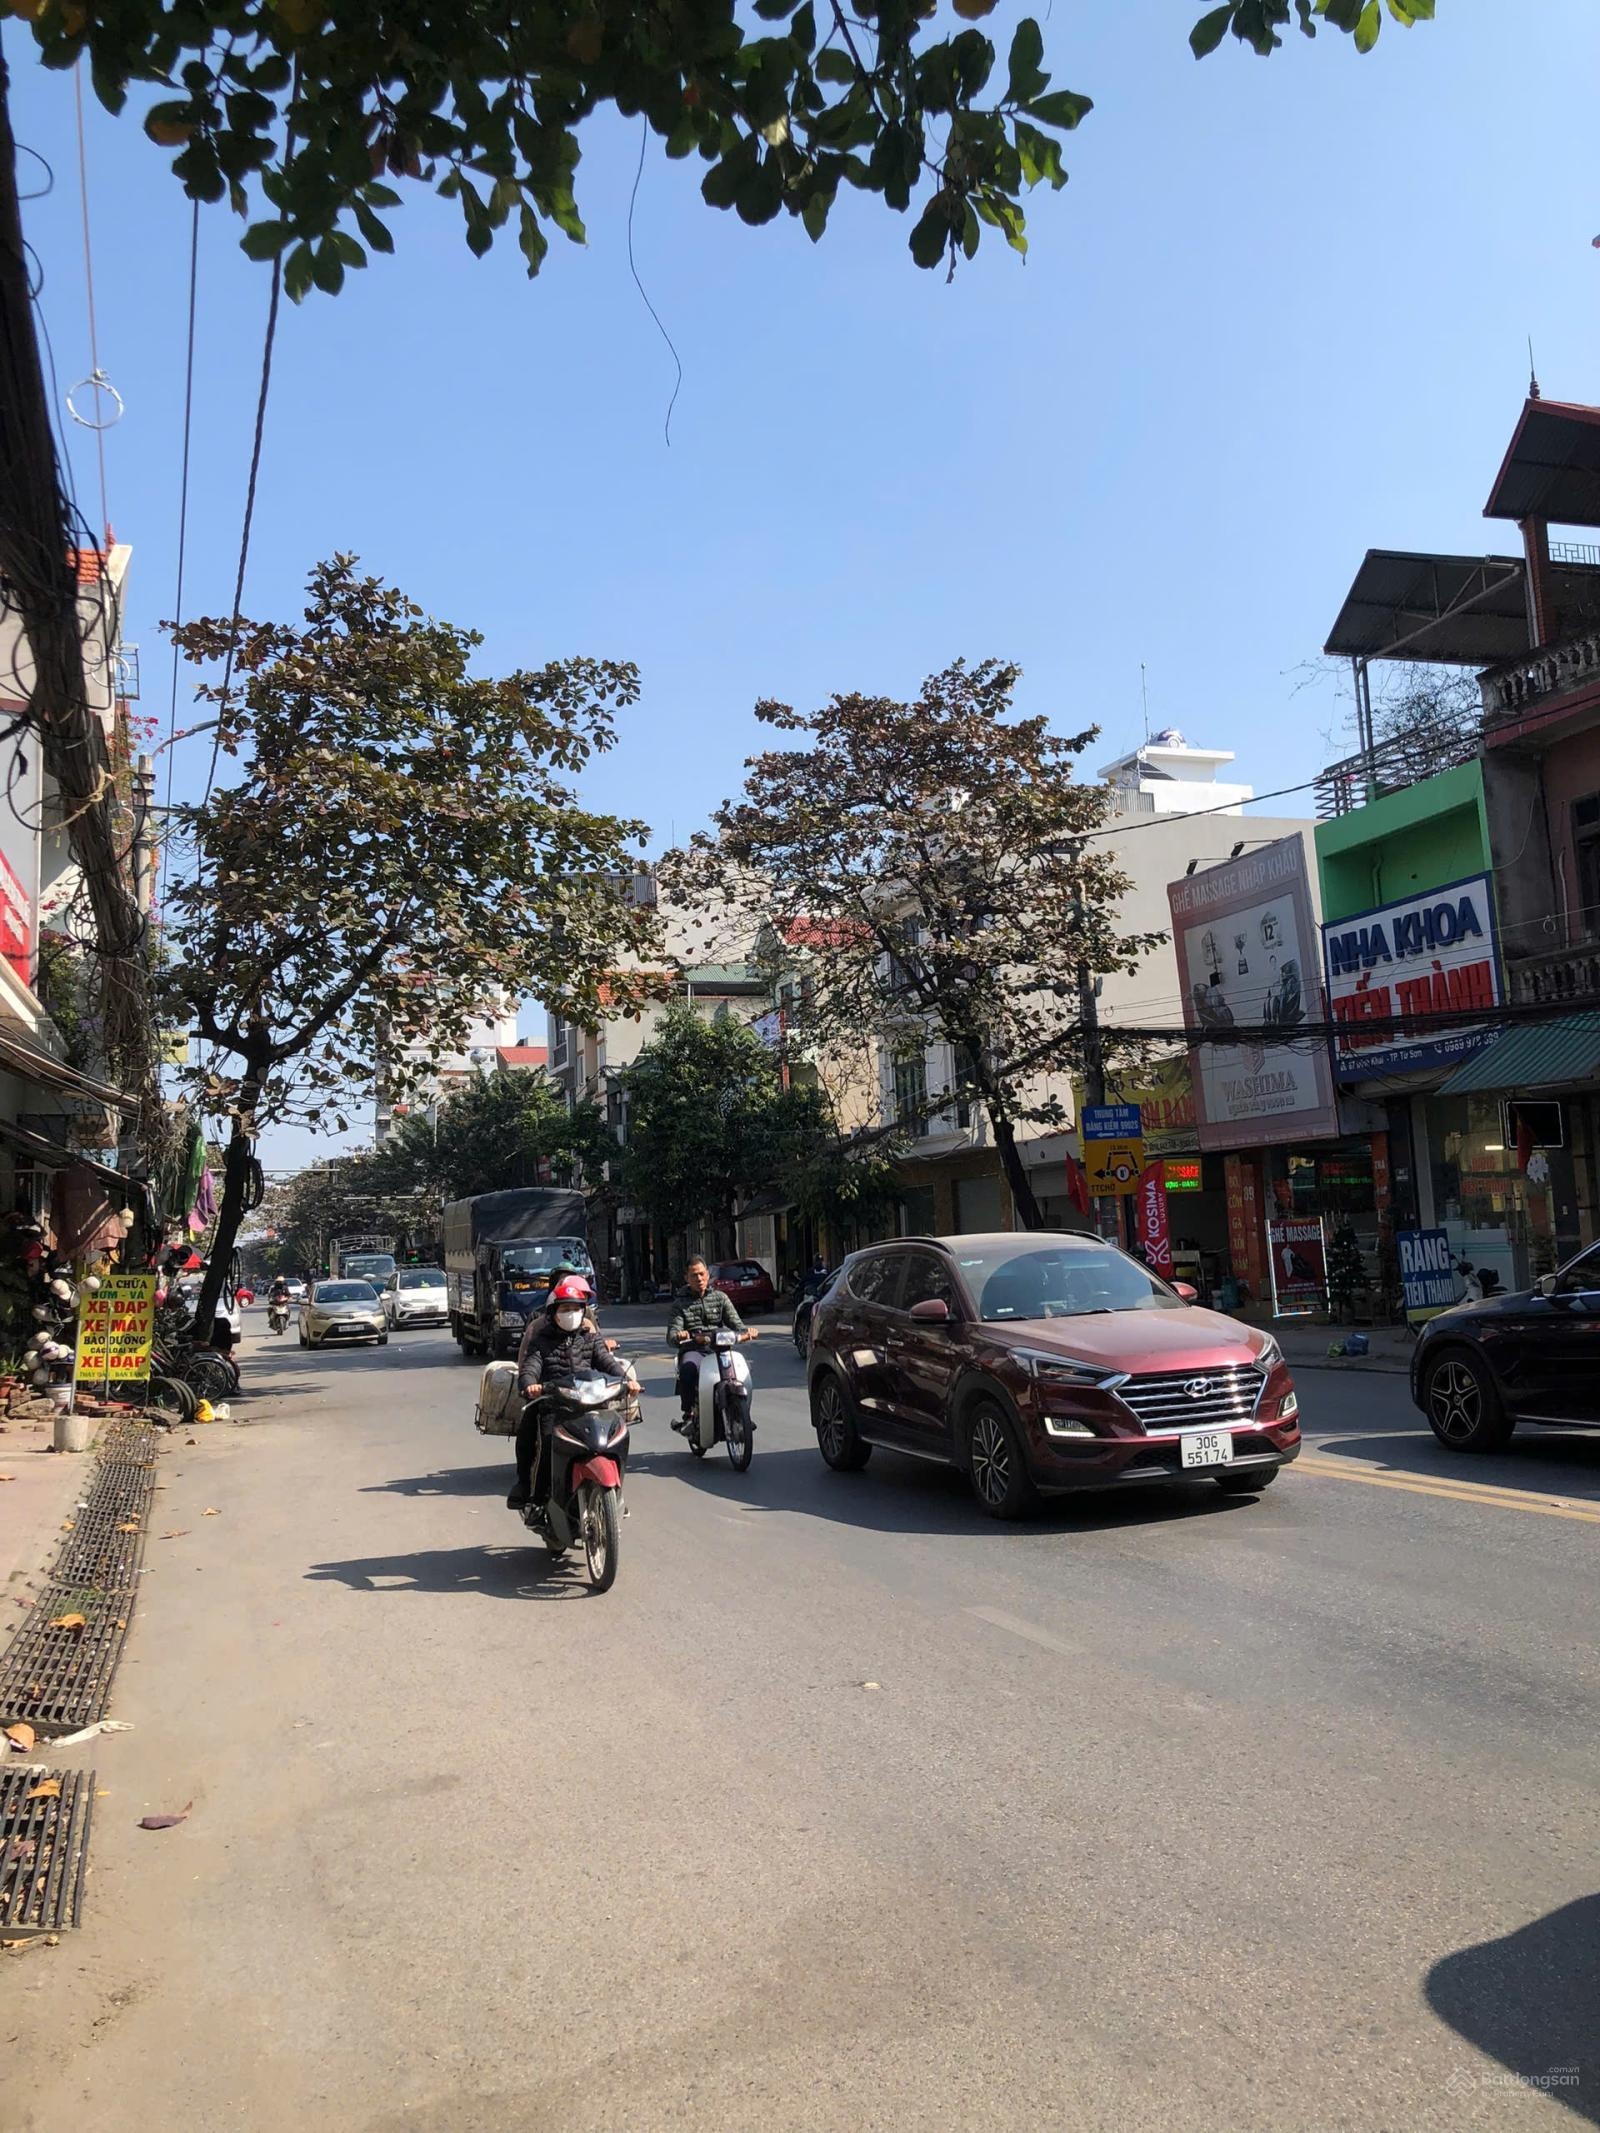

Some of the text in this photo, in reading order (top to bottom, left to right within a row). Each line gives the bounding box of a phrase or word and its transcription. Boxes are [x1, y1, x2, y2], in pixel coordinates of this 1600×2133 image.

[1190, 871, 1237, 908] MASSAGE
[1328, 896, 1483, 977] NHA KHOA
[1222, 1071, 1298, 1102] WASHIMA
[1145, 1179, 1160, 1238] KOSIMA
[1157, 1192, 1167, 1224] LUXURY
[1286, 1224, 1321, 1241] MASSAGE
[1399, 1232, 1450, 1273] RĂNG
[1403, 1274, 1455, 1306] TIẾN THÀNH
[87, 1300, 109, 1314] XE
[84, 1319, 106, 1333] XE
[83, 1332, 147, 1346] BẢO DƯỠNG
[81, 1355, 147, 1371] XE ĐẠP
[1195, 1435, 1218, 1450] 30G
[1187, 1448, 1228, 1465] 551.74
